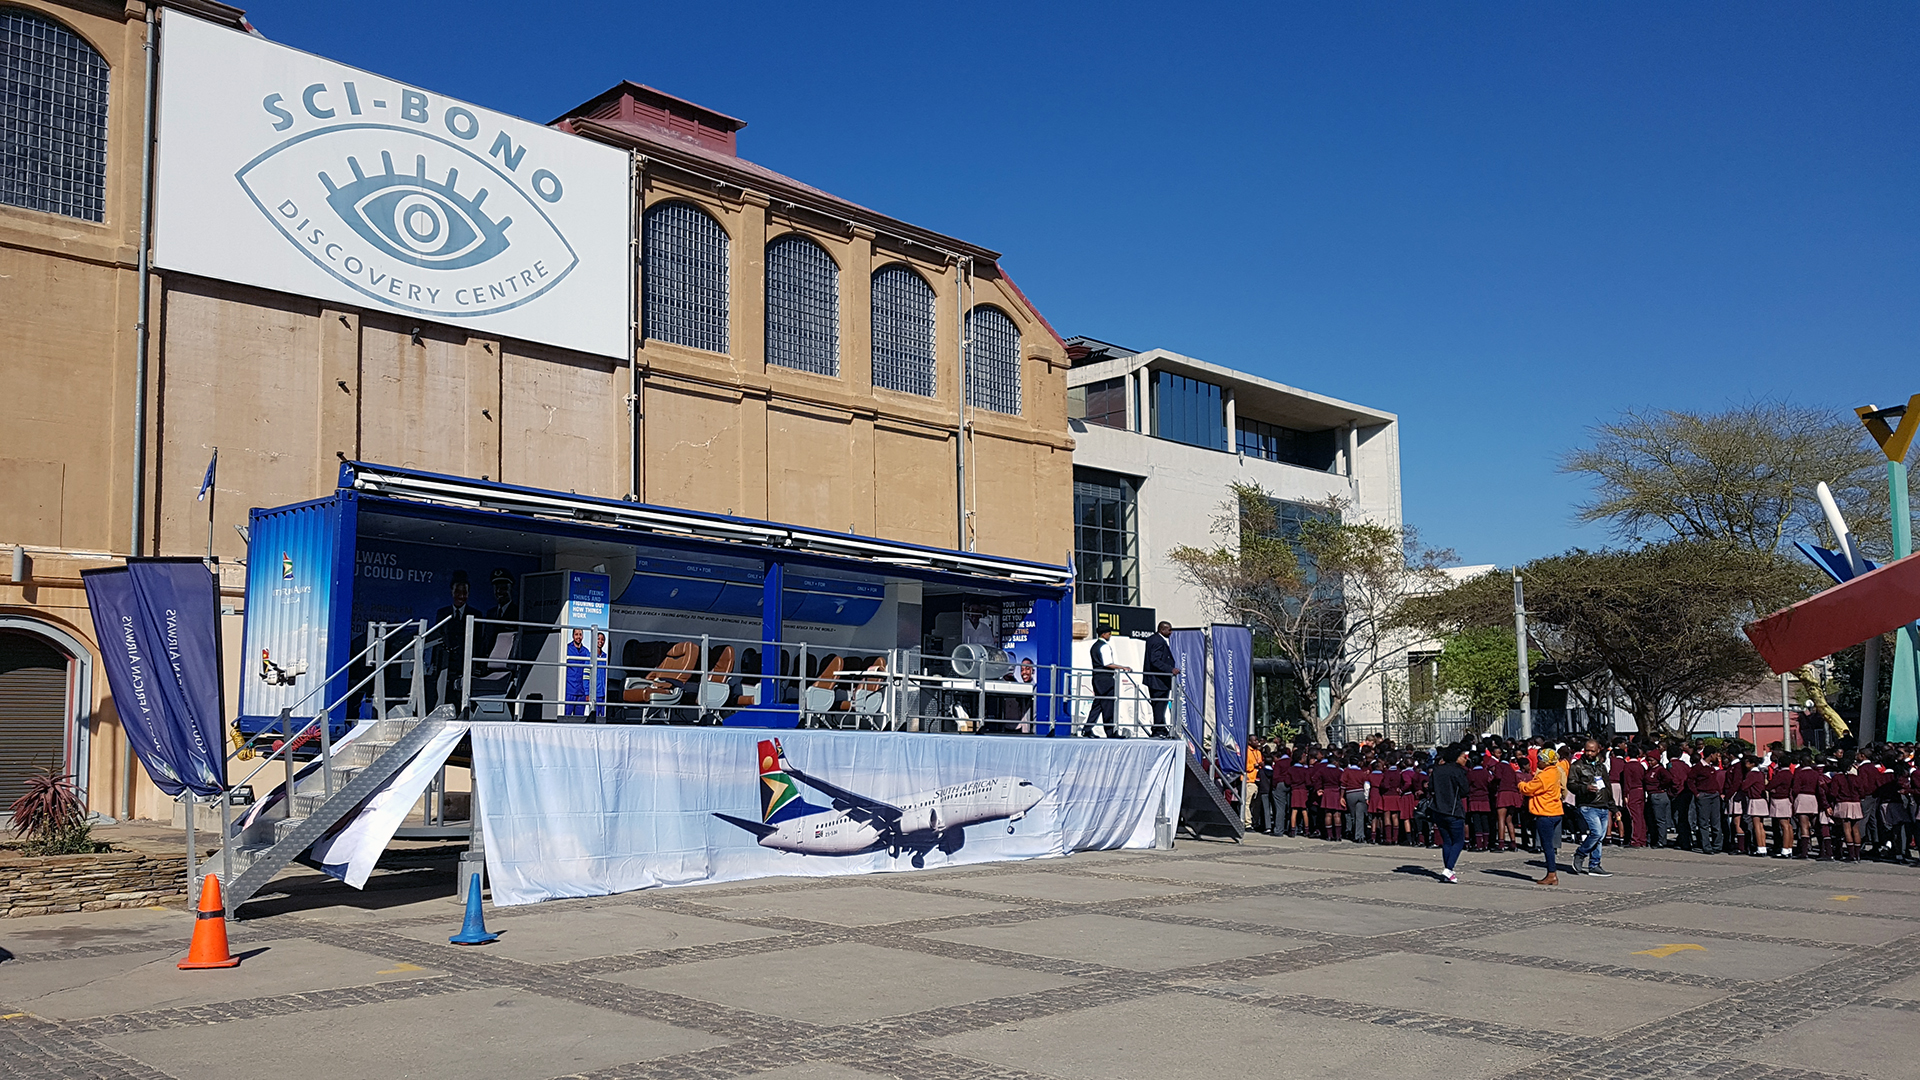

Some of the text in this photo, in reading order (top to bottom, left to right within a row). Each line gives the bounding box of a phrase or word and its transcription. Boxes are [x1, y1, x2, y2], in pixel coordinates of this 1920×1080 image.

[262, 81, 565, 204] SCI-BONO
[277, 199, 549, 306] DISCOVERY CENTRE
[355, 550, 398, 567] LWAYS
[363, 565, 405, 581] COULD
[407, 569, 434, 584] FLY?
